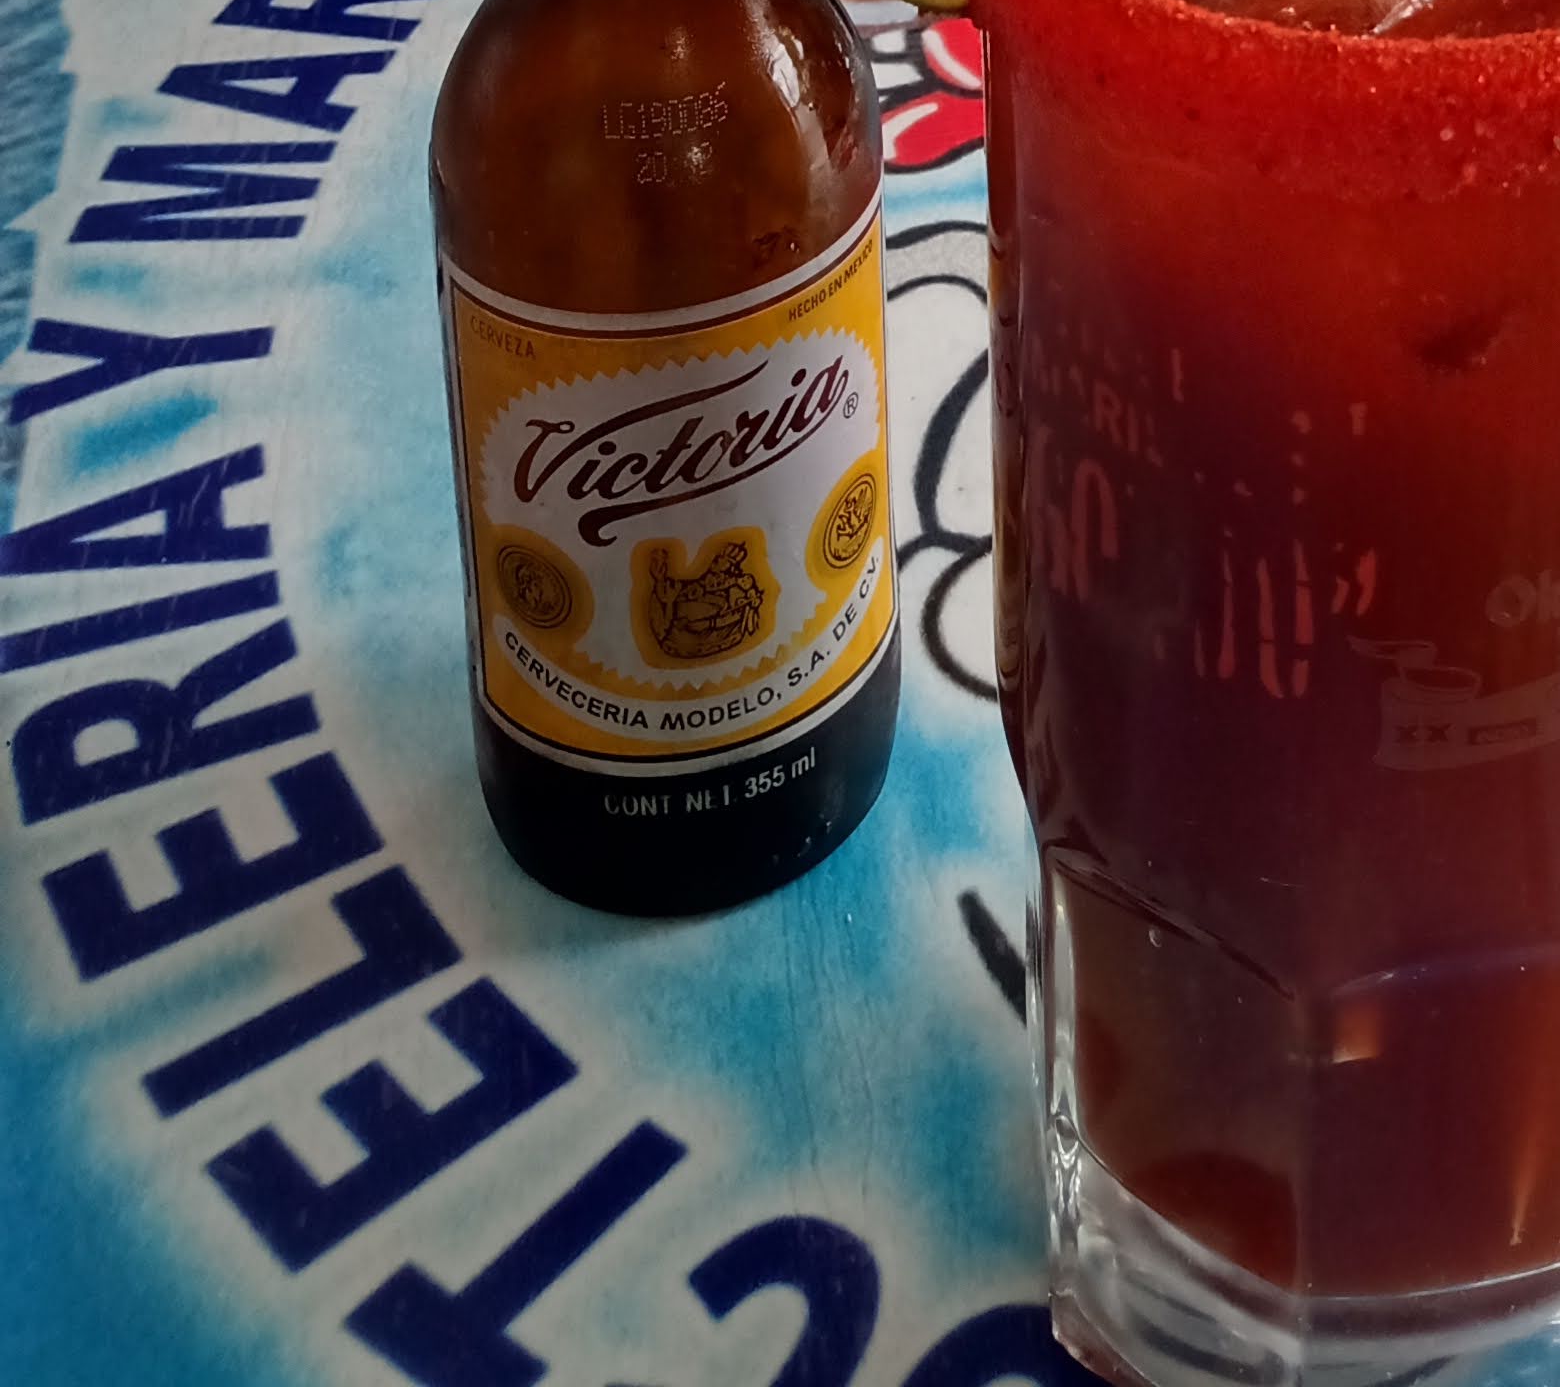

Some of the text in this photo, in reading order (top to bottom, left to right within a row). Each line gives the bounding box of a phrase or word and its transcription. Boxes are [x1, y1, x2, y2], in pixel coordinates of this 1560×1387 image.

[469, 315, 537, 360] CERVEZA
[788, 287, 827, 323] HECHO
[827, 274, 843, 300] EN
[10, 317, 276, 433] Y
[513, 354, 850, 546] Victoria
[659, 685, 783, 732] MODELO,
[786, 648, 831, 689] S.A.
[831, 603, 858, 642] DE
[858, 555, 881, 600] C.V.
[743, 764, 787, 800] 355
[790, 746, 817, 781] ml
